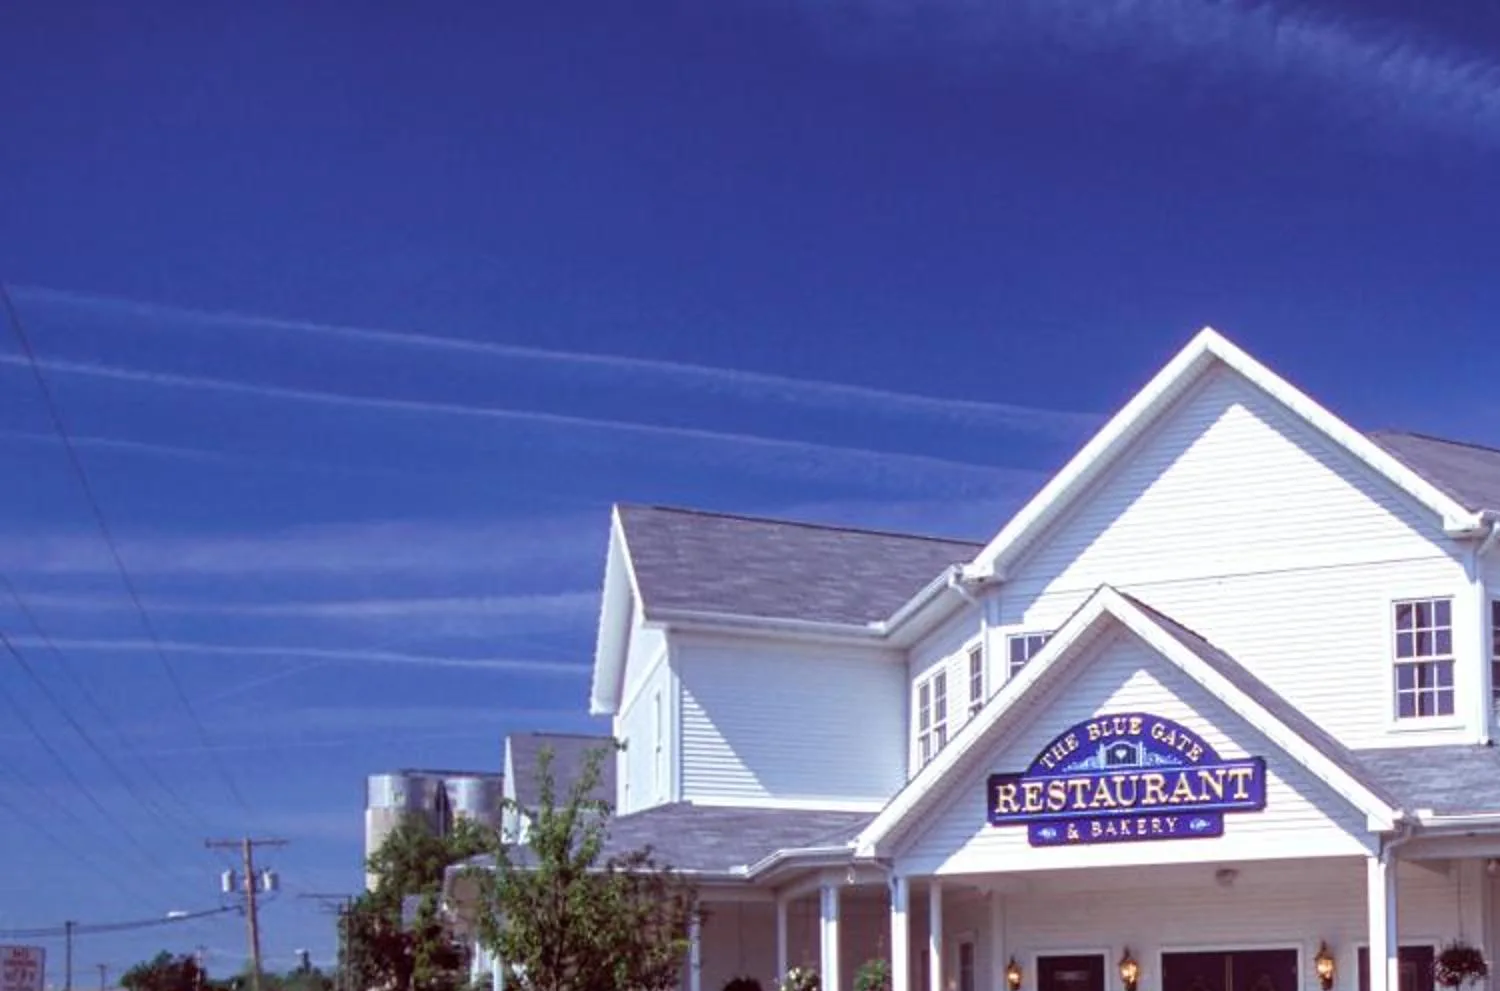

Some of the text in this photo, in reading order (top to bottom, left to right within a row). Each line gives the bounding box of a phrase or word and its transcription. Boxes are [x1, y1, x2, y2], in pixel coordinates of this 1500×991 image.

[1039, 717, 1203, 770] THE BLUE GATE
[995, 768, 1253, 814] RESTAURANT
[1066, 817, 1179, 840] & BAKERY
